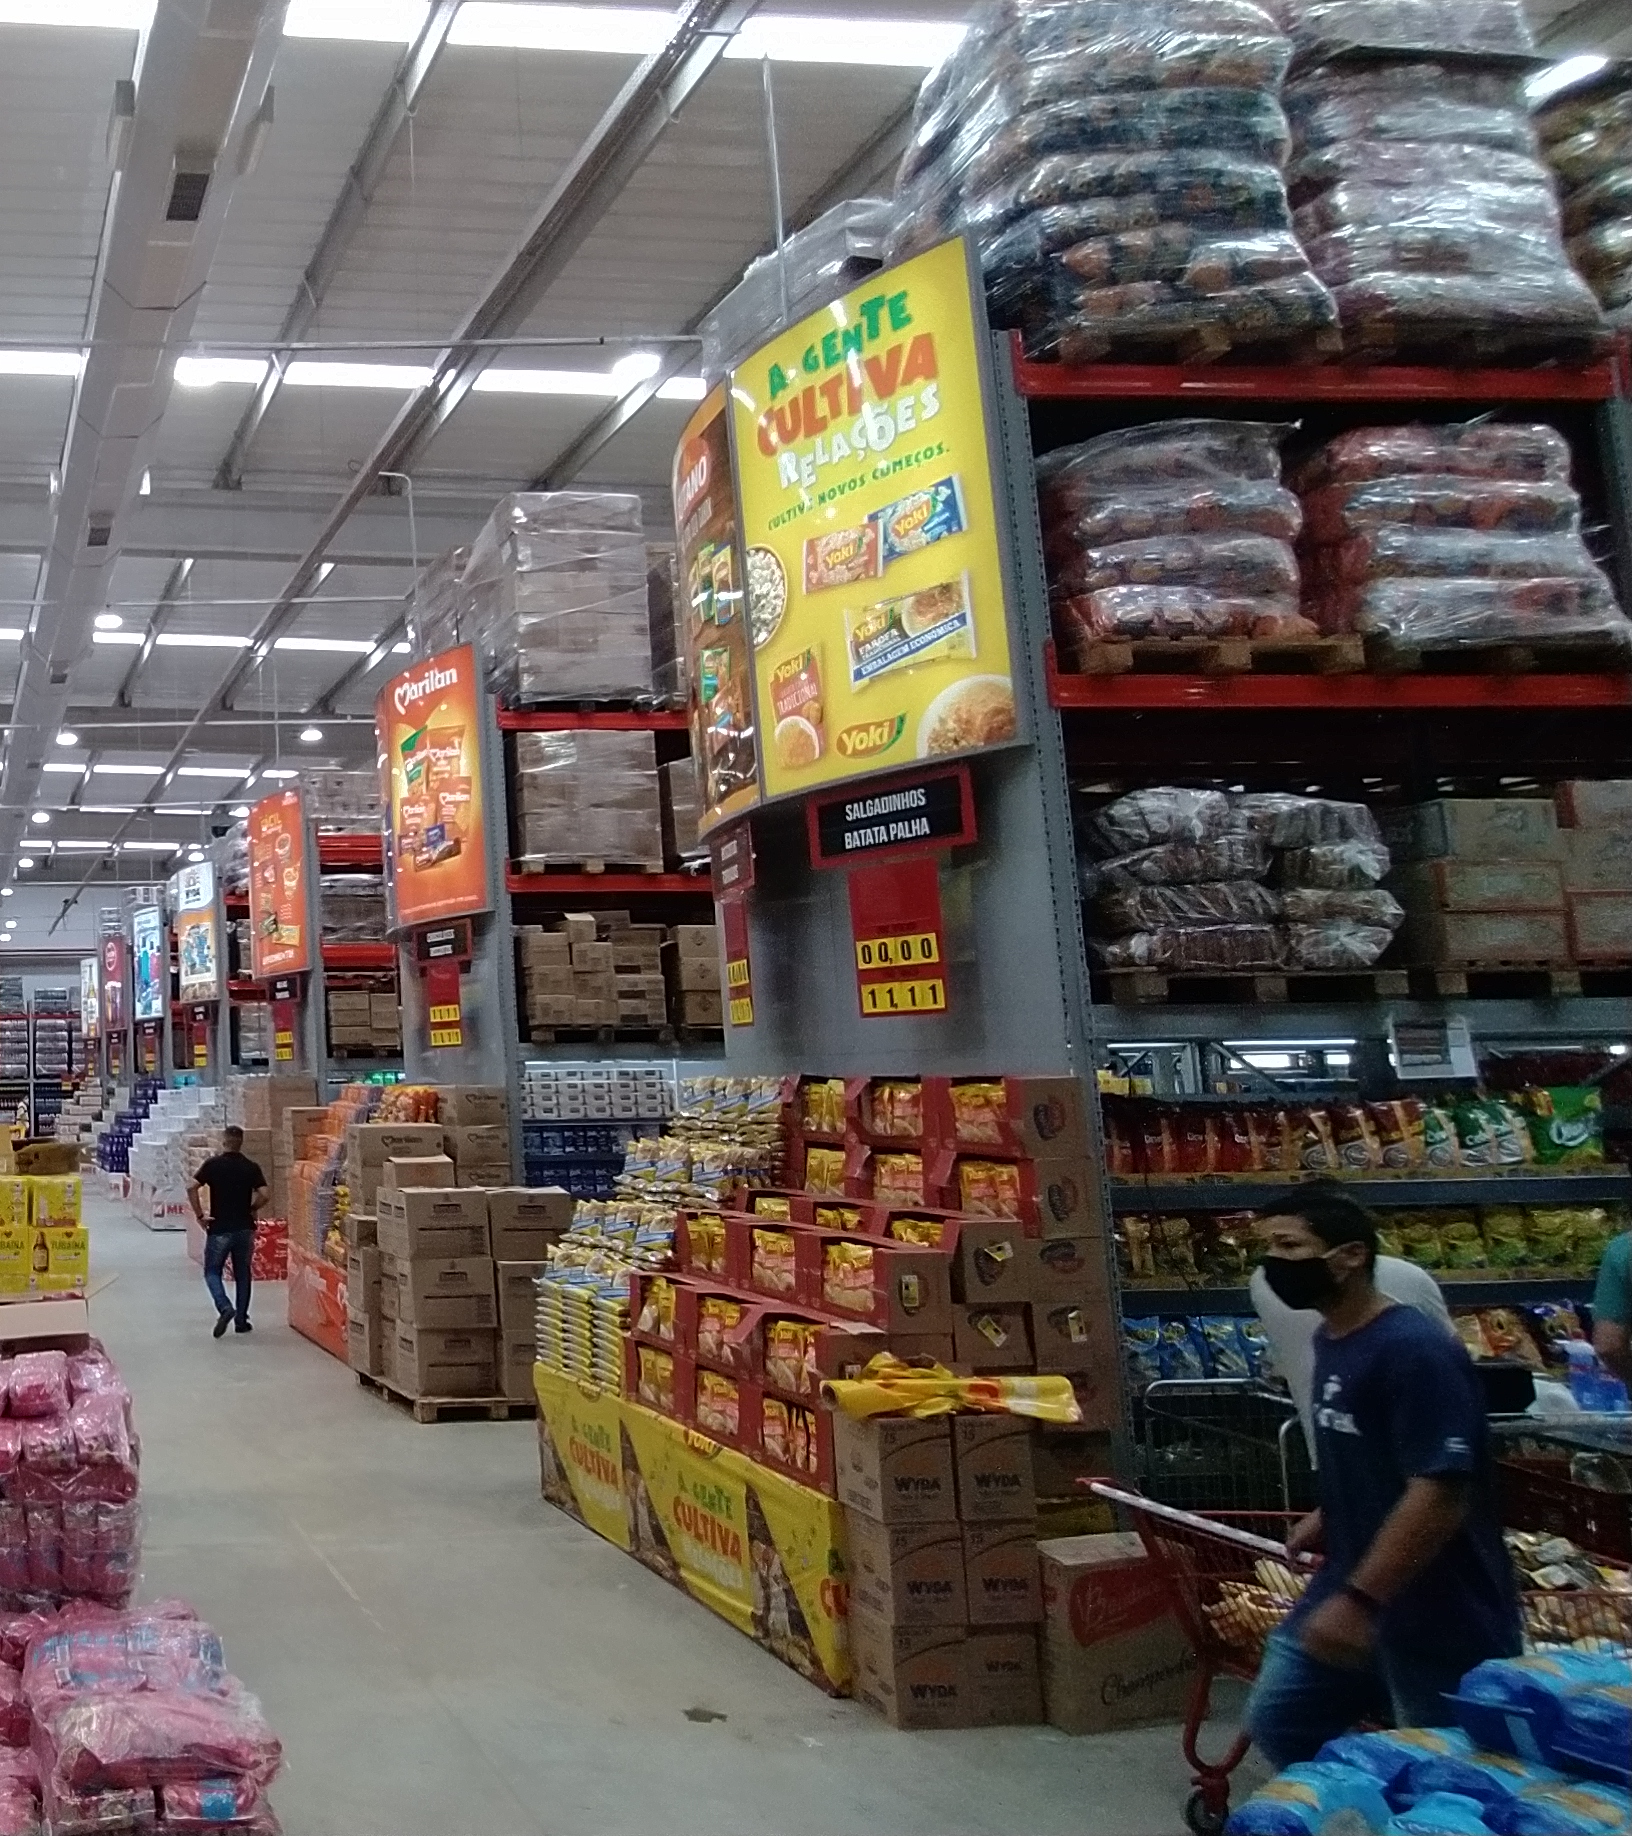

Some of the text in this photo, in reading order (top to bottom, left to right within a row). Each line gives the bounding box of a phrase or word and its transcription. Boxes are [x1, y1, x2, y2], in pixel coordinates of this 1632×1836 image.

[767, 289, 913, 400] A GENTE
[756, 332, 939, 458] CULTIVA
[776, 382, 941, 490] RELAÇÕES
[817, 473, 866, 506] NOVOS
[894, 503, 928, 536] Yoki
[825, 542, 854, 569] Yoki
[858, 627, 900, 656] FAROFA
[776, 654, 803, 683] Yoki
[394, 667, 458, 715] Marilan
[839, 721, 890, 755] Yoki
[845, 788, 927, 822] SALGADINHOS
[843, 816, 931, 850] BATATA PALHA
[860, 936, 933, 965] 00,00
[867, 982, 940, 1010] 11,11
[568, 1435, 619, 1489] CULTIVA
[894, 1475, 941, 1493] WYDA
[974, 1472, 1022, 1489] WYDA
[672, 1494, 743, 1565] CULTIVA
